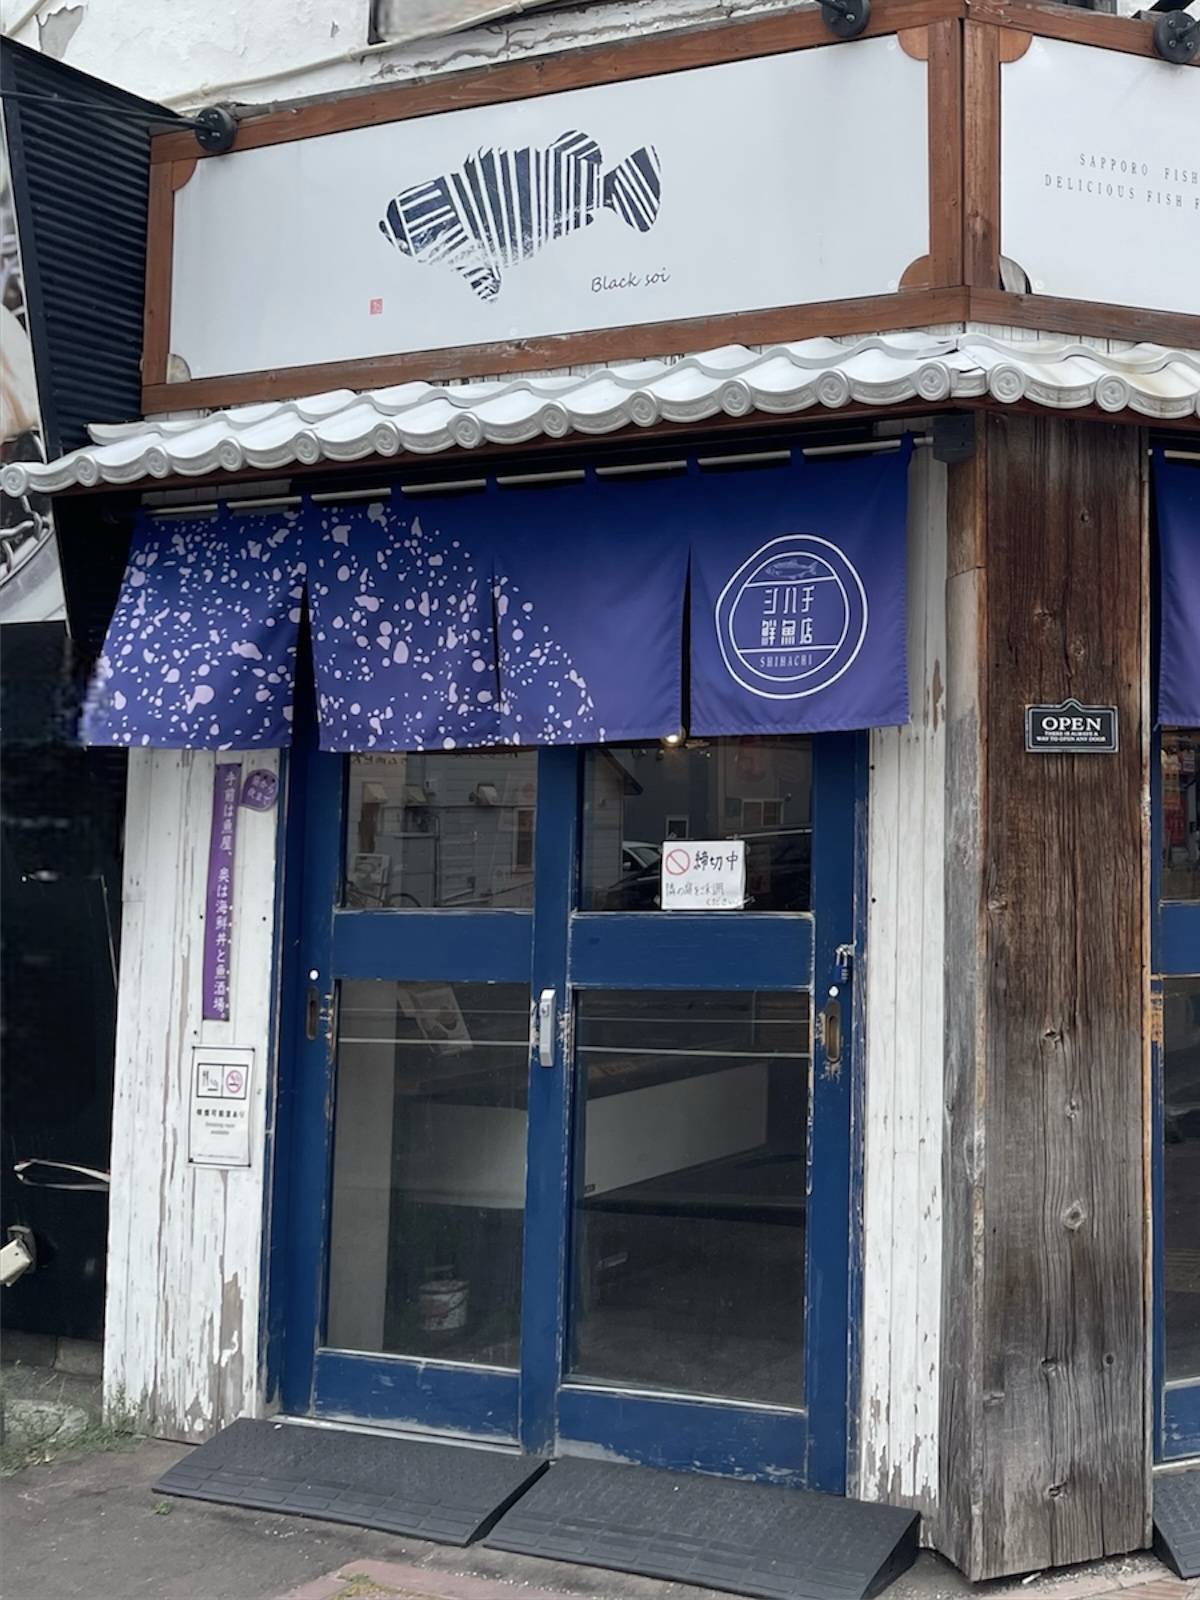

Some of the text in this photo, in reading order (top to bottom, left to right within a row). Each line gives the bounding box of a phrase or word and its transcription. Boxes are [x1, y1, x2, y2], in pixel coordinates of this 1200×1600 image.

[1079, 153, 1149, 177] SAPPORO
[1164, 167, 1199, 185] FISH
[1044, 173, 1136, 200] DELICIOUS
[1147, 190, 1183, 208] FISH
[591, 267, 671, 293] Black soi
[763, 585, 815, 615] シハチ
[760, 618, 813, 646] 鮮魚店
[759, 654, 813, 668] SHIHACHI
[1041, 716, 1102, 731] OPEN
[693, 850, 739, 872] 締切中
